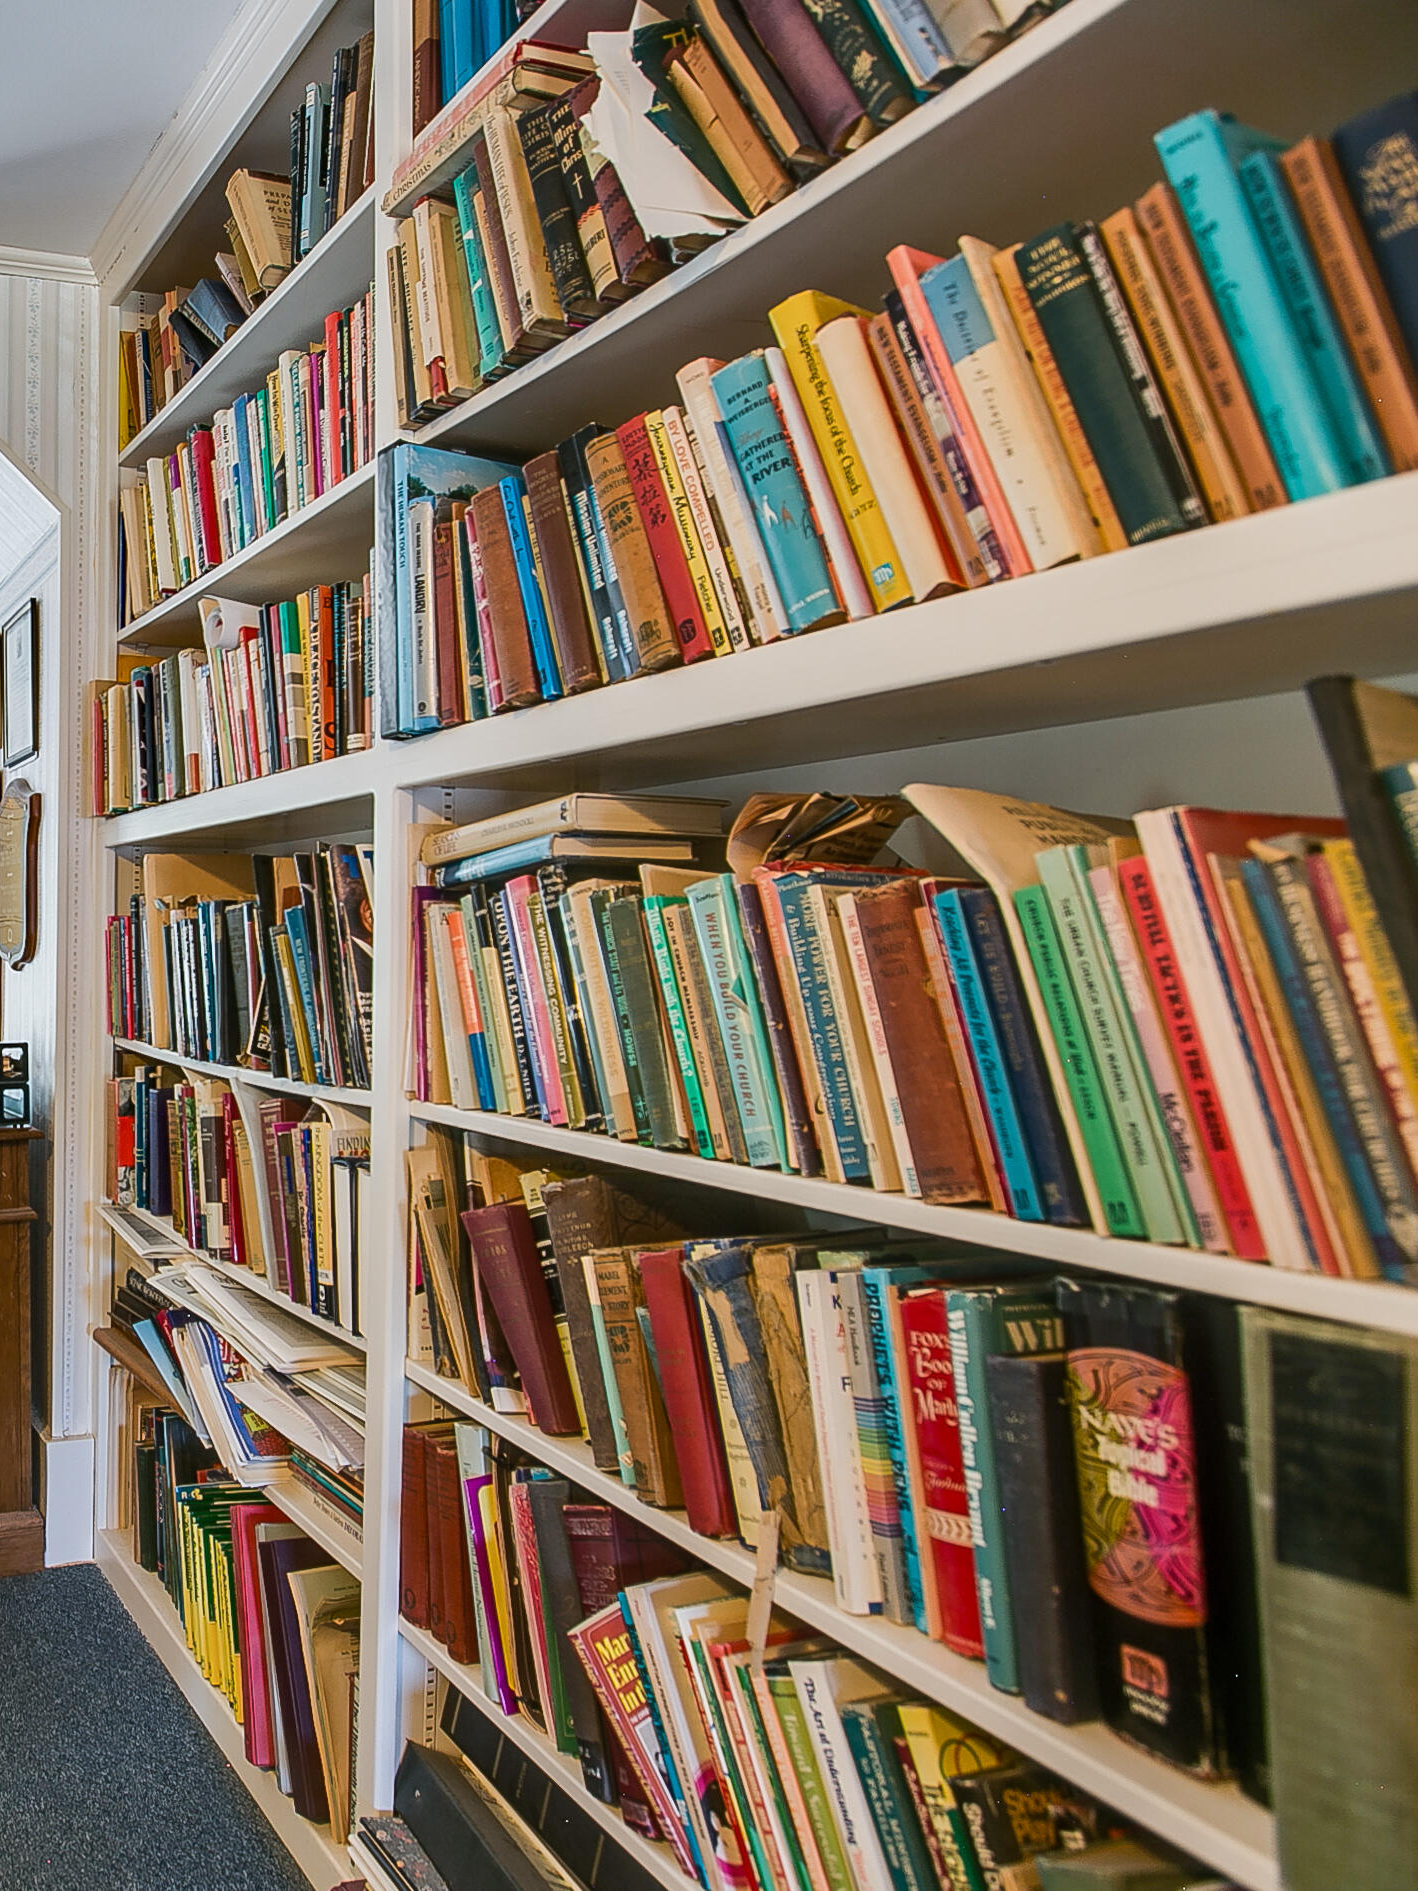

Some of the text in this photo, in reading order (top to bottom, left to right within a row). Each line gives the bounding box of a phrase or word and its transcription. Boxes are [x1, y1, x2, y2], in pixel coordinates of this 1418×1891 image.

[552, 104, 571, 122] THE
[486, 127, 502, 160] HUMAN
[561, 149, 582, 174] Chris
[563, 133, 574, 153] of
[492, 161, 507, 180] LIFE
[498, 186, 515, 218] JESUS
[943, 281, 962, 304] The
[726, 377, 766, 406] BERNARD
[791, 321, 864, 496] Sharpening the focus of the Church
[739, 431, 788, 462] GATHERED
[744, 449, 775, 473] AT THE
[666, 419, 718, 551] BY LOVE COMPELLED
[751, 456, 792, 485] RIVER
[572, 490, 607, 590] Mission Unlimited
[695, 573, 716, 611] Fletcher
[712, 566, 737, 621] Underwood
[309, 634, 321, 681] PLACE
[310, 683, 321, 700] TO
[310, 702, 322, 752] STAND
[533, 903, 544, 923] THE
[799, 891, 817, 930] MORE
[492, 900, 525, 1038] UPON THE EARTH
[537, 926, 557, 995] WITNESSING
[653, 945, 672, 979] Right
[786, 916, 810, 973] Building
[798, 976, 813, 998] Up
[808, 934, 828, 983] POWER
[578, 907, 618, 1078] COME OUT THE WILDERNESS
[661, 981, 678, 1007] with
[665, 915, 674, 932] JOY
[673, 947, 686, 982] CHURCH
[682, 984, 699, 1040] MEMBERSHIP
[845, 913, 887, 1056] THE TEN LARGEST SUNDAY SCHOOLS
[667, 1008, 682, 1025] the
[703, 912, 757, 1117] WHEN YOU BUILD YOUR CHURCH
[818, 987, 835, 1018] FOR
[1076, 958, 1101, 1005] CHURCH
[1091, 1004, 1114, 1048] SURVEY
[549, 997, 569, 1064] COMMUNITY
[825, 1021, 843, 1062] YOUR
[671, 1027, 693, 1079] Church?
[521, 1067, 532, 1099] NILES
[981, 1056, 1001, 1095] Church
[834, 1066, 856, 1126] CHURCH
[337, 1136, 371, 1150] FINDIN
[313, 1143, 324, 1198] KINGDOM
[316, 1232, 326, 1267] CULTS
[598, 1271, 620, 1280] MABEL
[910, 1347, 952, 1378] Boo
[945, 1308, 974, 1397] William
[861, 1281, 912, 1514] PROPHETS WITH PENS
[926, 1379, 948, 1391] OF
[955, 1394, 981, 1463] Cullen
[964, 1466, 990, 1547] Bryant
[595, 1632, 631, 1666] Mar
[606, 1659, 639, 1689] Enr
[802, 1677, 819, 1703] The
[809, 1703, 827, 1730] Art
[821, 1746, 861, 1845] Understanding
